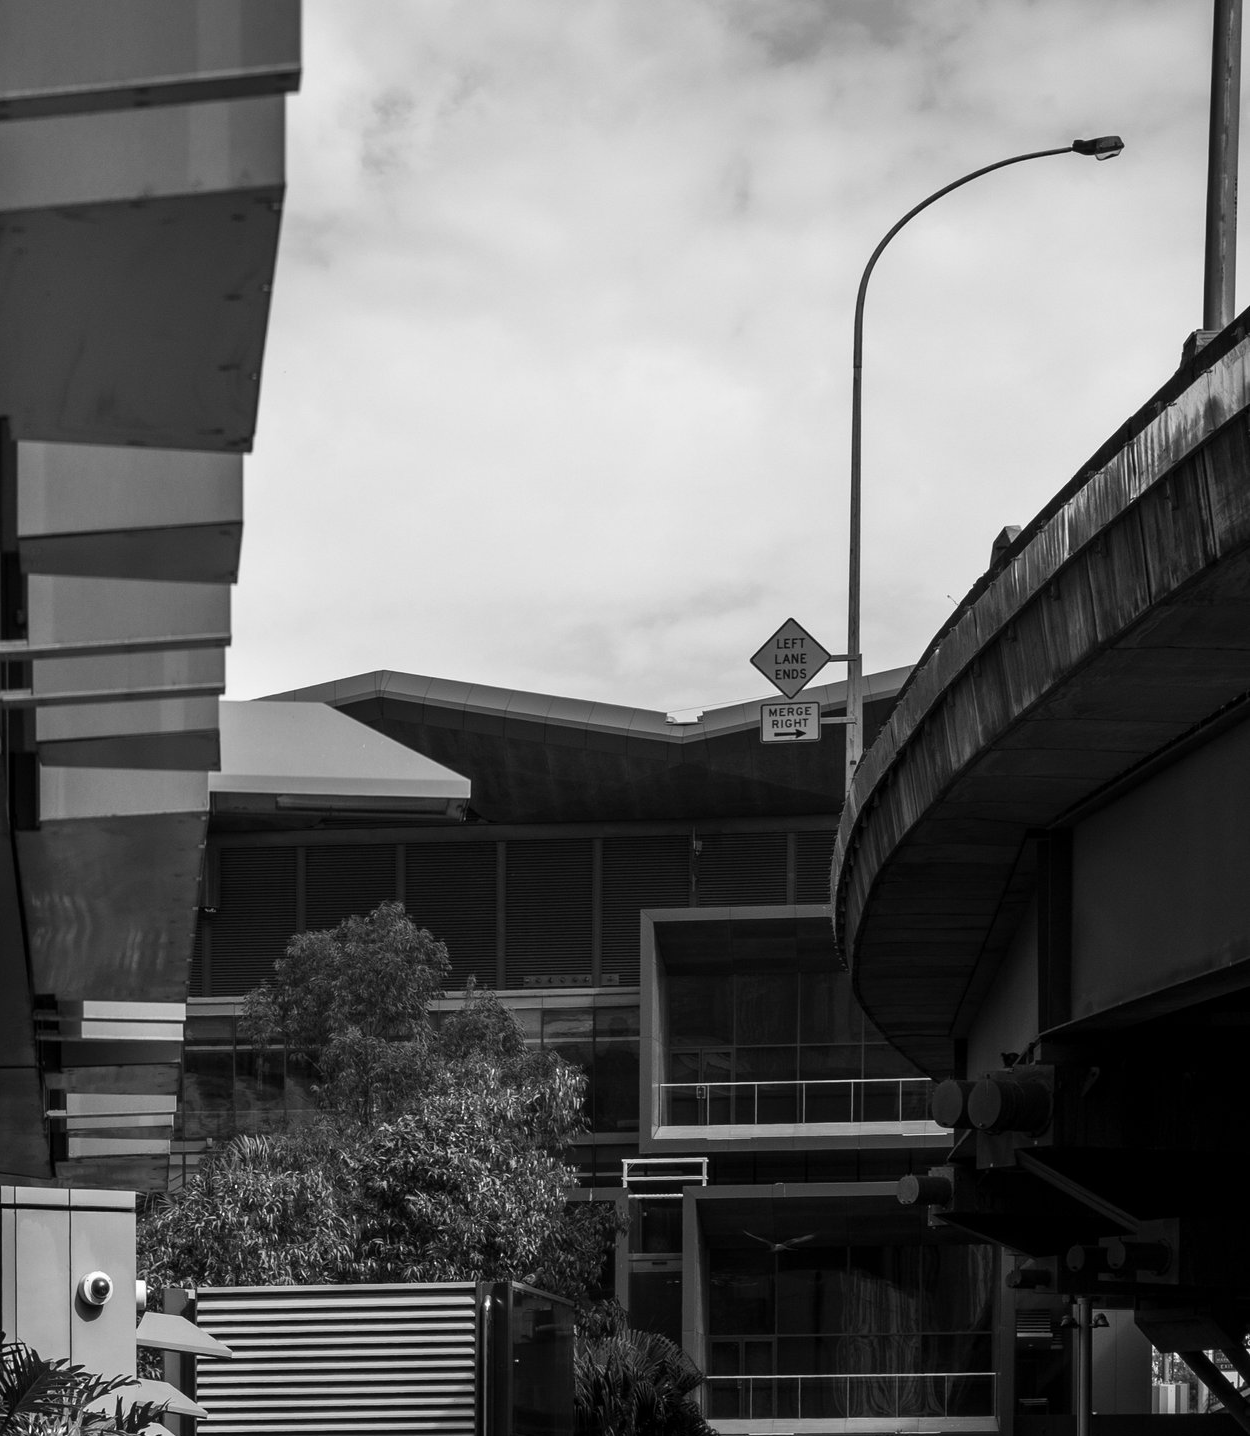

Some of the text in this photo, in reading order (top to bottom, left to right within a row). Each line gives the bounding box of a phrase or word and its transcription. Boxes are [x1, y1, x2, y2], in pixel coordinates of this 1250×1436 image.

[776, 638, 806, 649] LEFT
[774, 653, 807, 665] LANE
[775, 669, 807, 680] ENDS
[769, 706, 812, 717] MERGE
[772, 718, 809, 729] RIGHT
